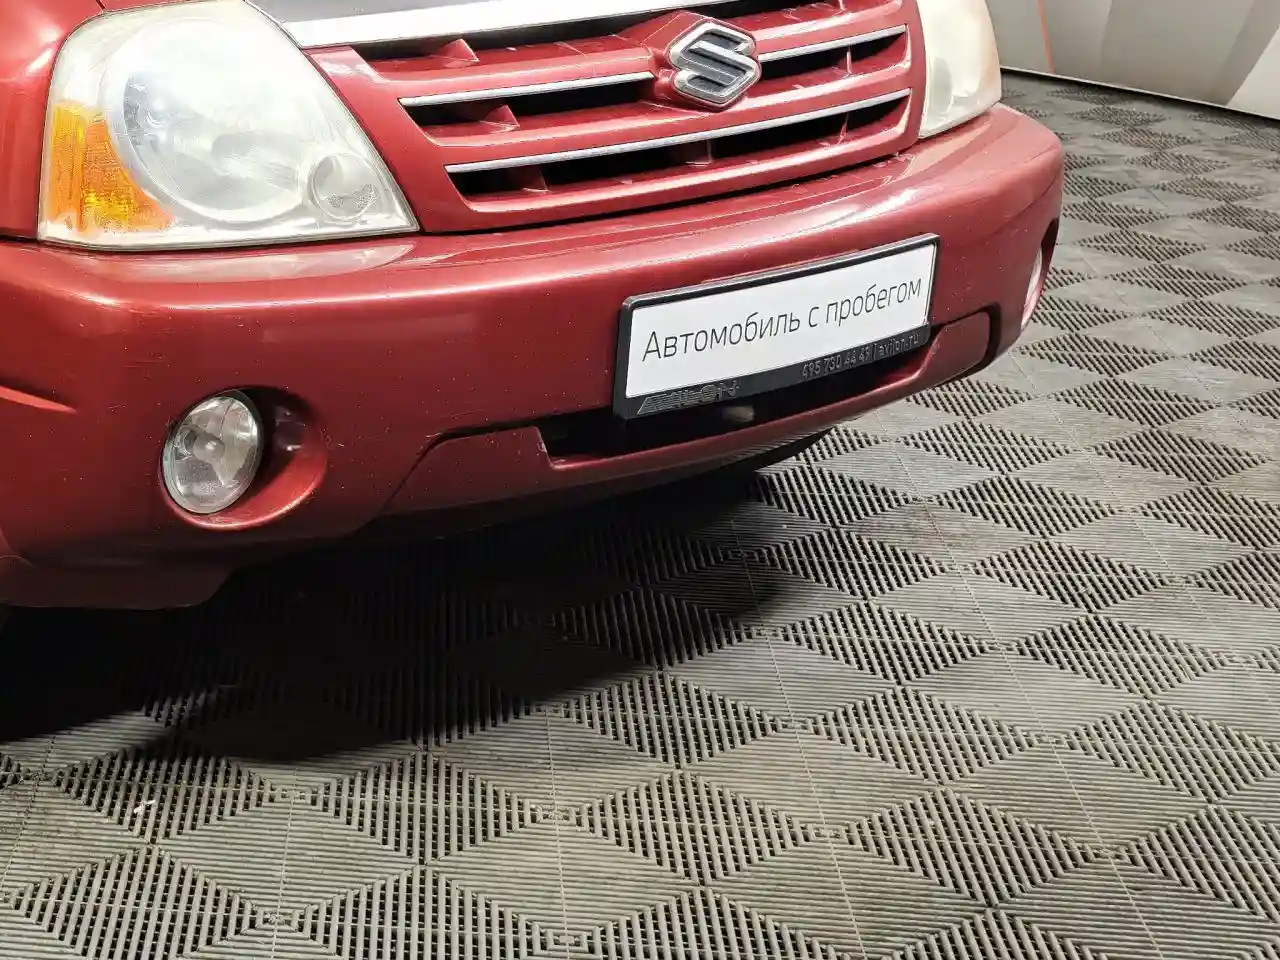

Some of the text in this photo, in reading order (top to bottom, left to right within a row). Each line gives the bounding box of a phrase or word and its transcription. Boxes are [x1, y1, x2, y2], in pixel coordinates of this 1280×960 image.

[641, 277, 922, 362] Автомобиль с пробегом
[801, 360, 821, 379] 495
